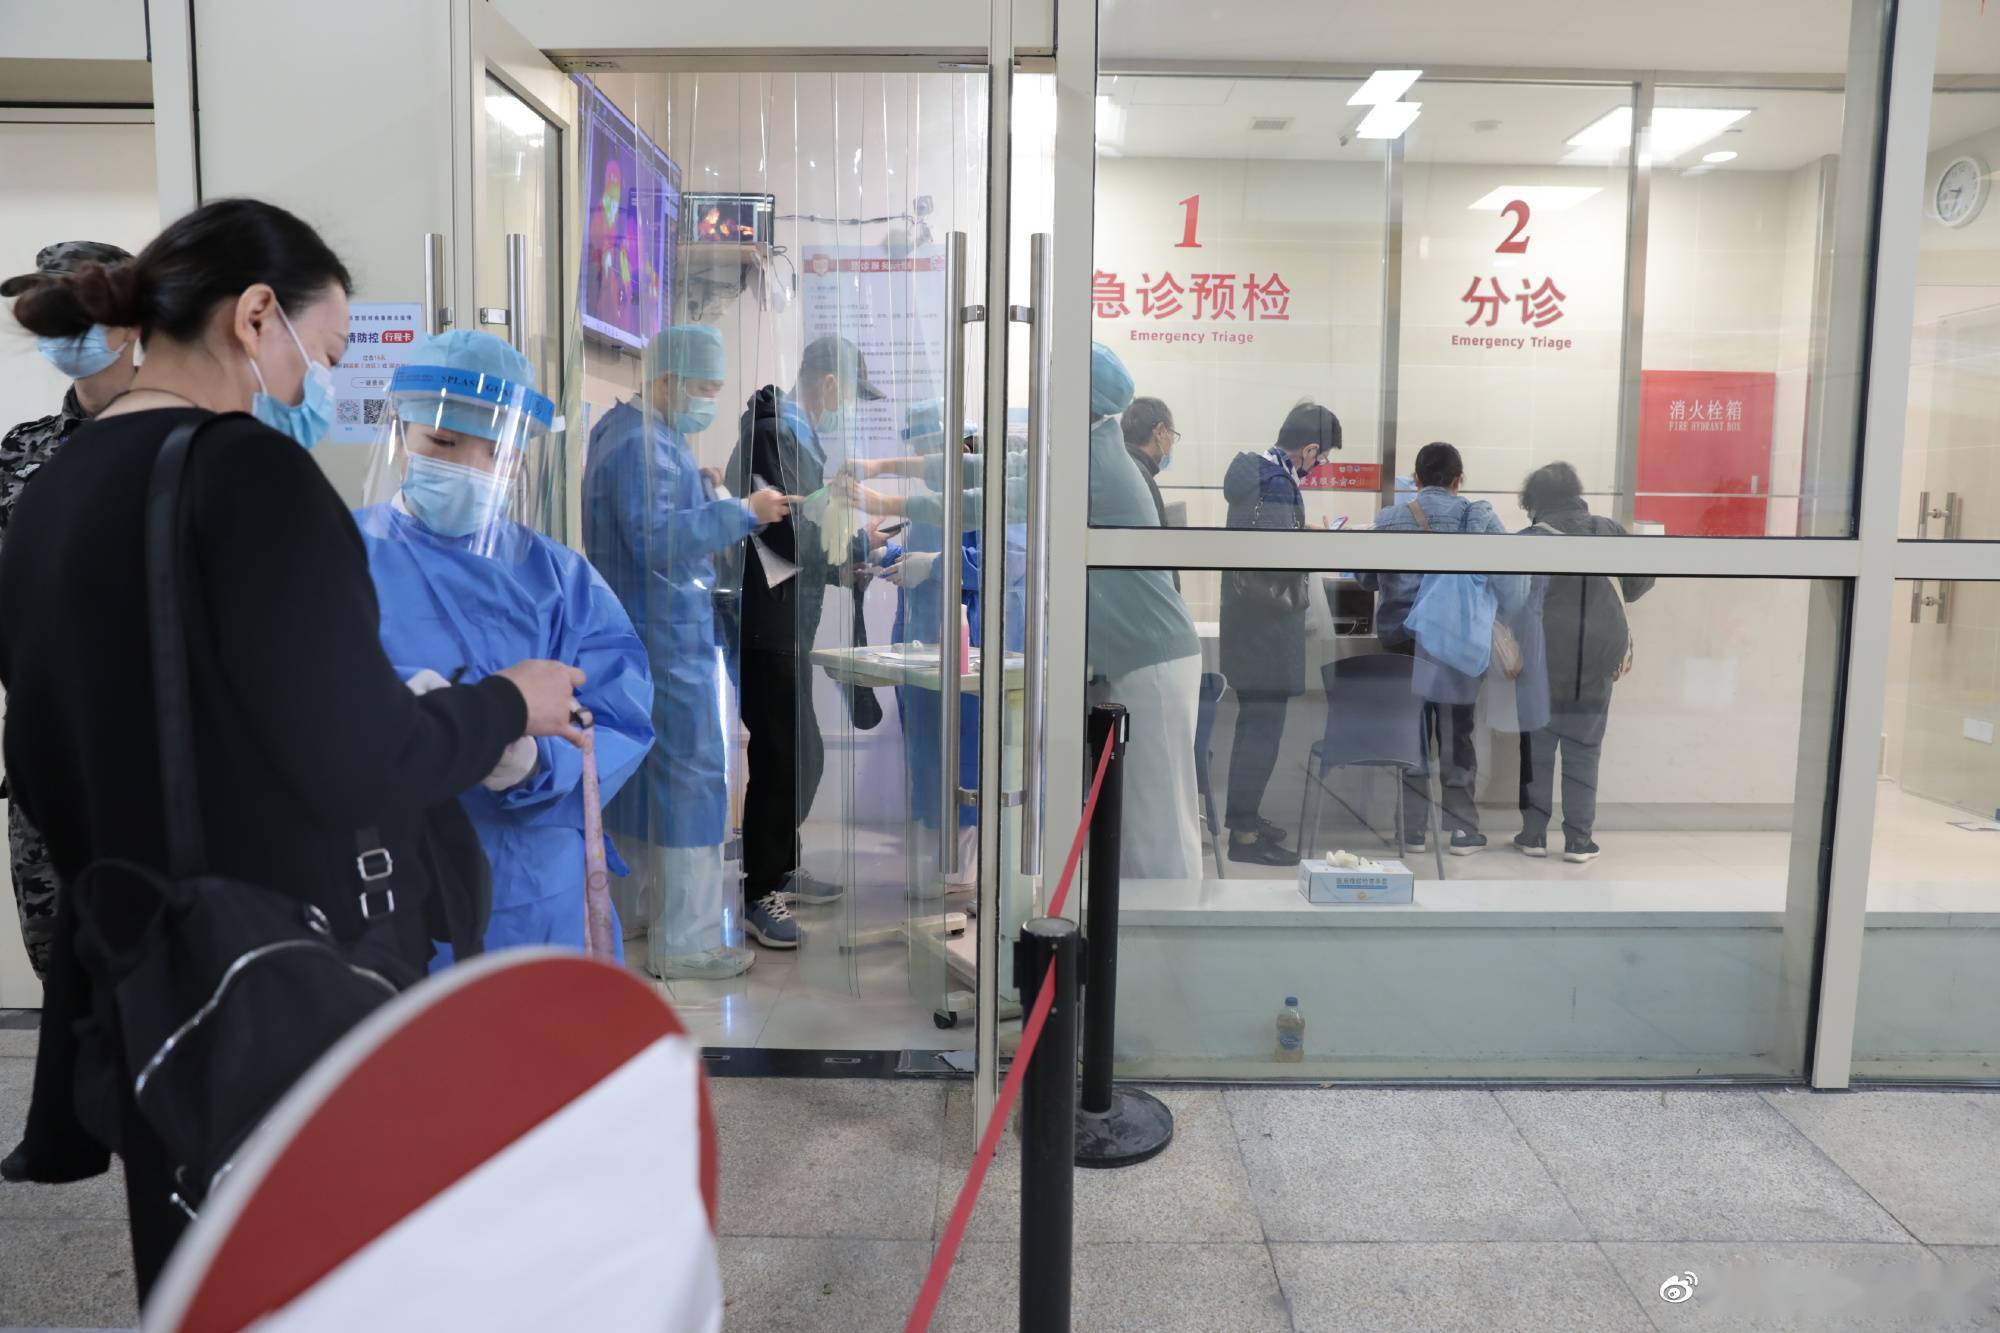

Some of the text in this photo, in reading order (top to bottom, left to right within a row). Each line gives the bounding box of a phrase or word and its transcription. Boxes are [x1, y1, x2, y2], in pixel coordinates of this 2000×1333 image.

[1174, 194, 1203, 248] 1
[1495, 199, 1531, 254] 2
[1092, 269, 1291, 321] 急诊预检
[1461, 276, 1567, 328] 分诊
[384, 332, 412, 342] 行程卡
[1130, 330, 1254, 344] Emergency Triage
[1451, 335, 1572, 350] Emergency Triage
[1669, 399, 1743, 421] 消火栓箱
